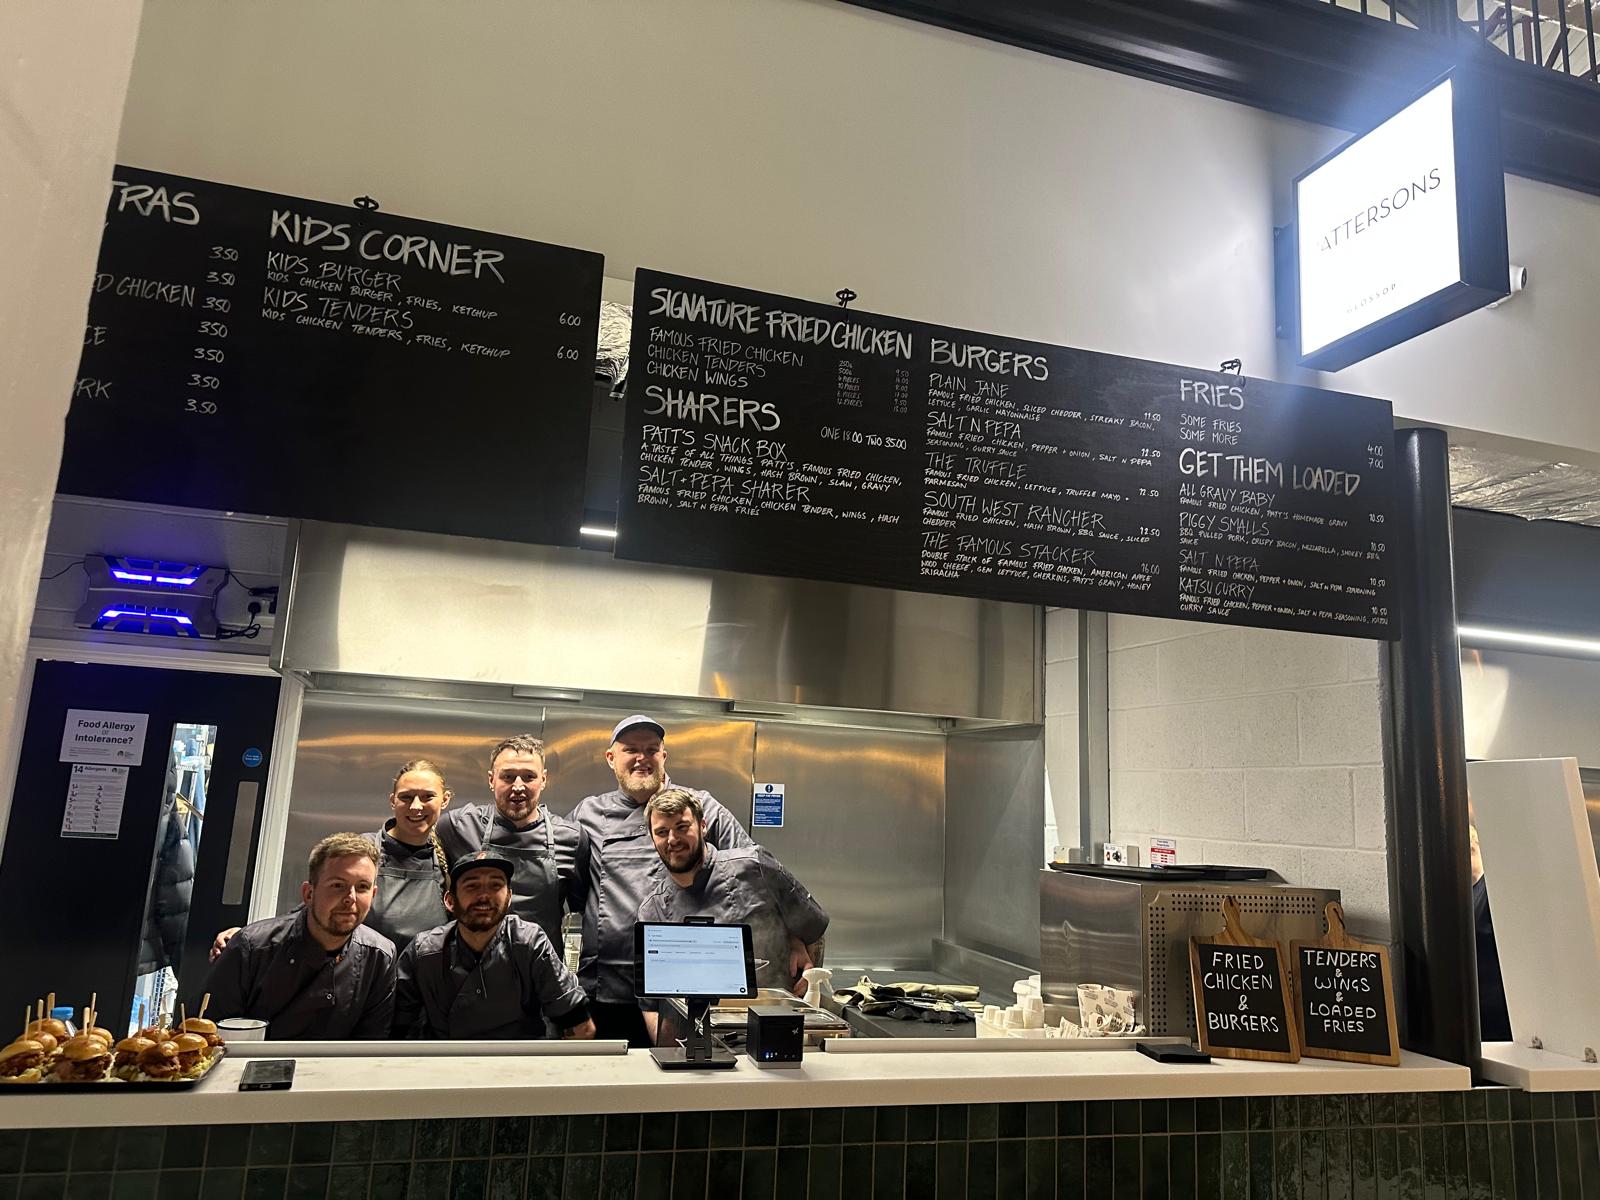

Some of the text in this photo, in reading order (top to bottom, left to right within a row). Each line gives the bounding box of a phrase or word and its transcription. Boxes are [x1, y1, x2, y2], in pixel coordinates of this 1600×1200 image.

[270, 209, 505, 283] KIDS CORNER
[267, 251, 401, 292] KIDS BURGER
[94, 272, 196, 308] D CHICKEN
[267, 270, 289, 283] KIDS
[300, 277, 342, 292] CHICKEN
[407, 296, 442, 312] FRIES,
[452, 304, 498, 319] KETCHUP
[559, 313, 581, 327] 6.00
[263, 287, 414, 329] KIDS TENDERS
[262, 308, 286, 321] KIDS
[296, 314, 343, 331] CHICKEN
[416, 334, 452, 351] FRIES,
[460, 342, 511, 359] KETCHUP
[557, 346, 579, 361] 6.00
[649, 288, 912, 359] SIGNATURE FRIED CHICKEN
[194, 348, 225, 363] 3.50
[649, 326, 804, 367] FAMOUS FRIED CHICKEN
[647, 344, 766, 378] CHICKEN TENDERS
[930, 338, 1049, 381] BURGERS
[186, 374, 220, 390] 3.50
[646, 361, 749, 388] CHICKEN WINGS
[929, 373, 1008, 398] PLAIN JANE
[74, 378, 112, 399] RK
[1180, 378, 1244, 410] FRIES
[184, 399, 217, 414] 3.50
[643, 385, 780, 432] SHARERS
[928, 388, 954, 399] FAMOUS
[960, 393, 981, 403] FRIED
[1023, 404, 1046, 413] SLICED
[1090, 415, 1124, 425] STREAKY
[966, 405, 989, 413] GARLIC
[927, 411, 1021, 439] SALT N PEPA
[1180, 413, 1242, 433] SOME FRIES
[642, 425, 787, 461] PATT'S SNACK BOX
[820, 426, 840, 440] ONE
[866, 434, 883, 446] TWO
[926, 427, 953, 438] FAMOUS
[958, 433, 984, 443] FRIED
[1031, 443, 1058, 454] PEPPER
[1099, 453, 1117, 462] SALT
[1180, 427, 1238, 446] SOME MORE
[652, 443, 679, 455] TASTE
[684, 448, 697, 457] OF
[700, 451, 715, 460] ALL
[720, 453, 754, 465] THINGS
[802, 463, 832, 476] FAMOUS
[837, 467, 862, 479] FRIED
[973, 445, 1017, 457] CURRY SAUCE
[640, 452, 890, 492] CHICKEN HASH GRAVY
[925, 452, 1027, 480] THE TRUFFLE
[1179, 447, 1360, 496] GET THEM LOADED
[638, 465, 810, 502] SALT PEPA SHARER
[924, 468, 951, 478] FAMOUS
[957, 473, 979, 483] FRIED
[1066, 489, 1096, 497] TRUFFLE
[924, 477, 967, 488] PARMESAN
[638, 483, 900, 524] FAMOUS FRIED CHICKEN HASH
[1179, 483, 1275, 508] ALL GRAVY BABY
[1208, 502, 1227, 511] FRIED
[710, 503, 728, 512] PEPA
[735, 506, 760, 516] FRIES
[923, 507, 949, 517] FAMOUS
[956, 512, 978, 522] FRIED
[1024, 522, 1043, 530] HASH
[925, 491, 1106, 530] SOUTH WEST RANCHER
[922, 517, 956, 528] CHEDDER
[1180, 512, 1270, 536] PIGGY SMALLS
[1199, 531, 1223, 539] PULLED
[922, 531, 1097, 566] THE FAMOUS STACKER
[1180, 549, 1260, 572] SALT N PEPA
[922, 550, 949, 560] DOUBLE
[955, 554, 977, 563] STACK
[1033, 562, 1054, 571] FRIED
[1091, 568, 1128, 580] AMERICAN
[1179, 576, 1255, 602] KATSU CURRY
[1180, 603, 1231, 616] CURRY SAUCE
[78, 720, 136, 732] Food Allergy
[75, 733, 134, 745] Intolerance?
[1212, 951, 1264, 970] FRIED
[1303, 949, 1377, 969] TENDERS
[1203, 972, 1273, 990] CHICKEN
[1314, 977, 1371, 992] WINGS
[1335, 968, 1343, 978] &
[1238, 994, 1249, 1011] &
[1335, 991, 1344, 1003] &
[1309, 1001, 1377, 1019] LOADED
[1208, 1012, 1280, 1033] BURGERS
[1323, 1019, 1365, 1033] FRIES
